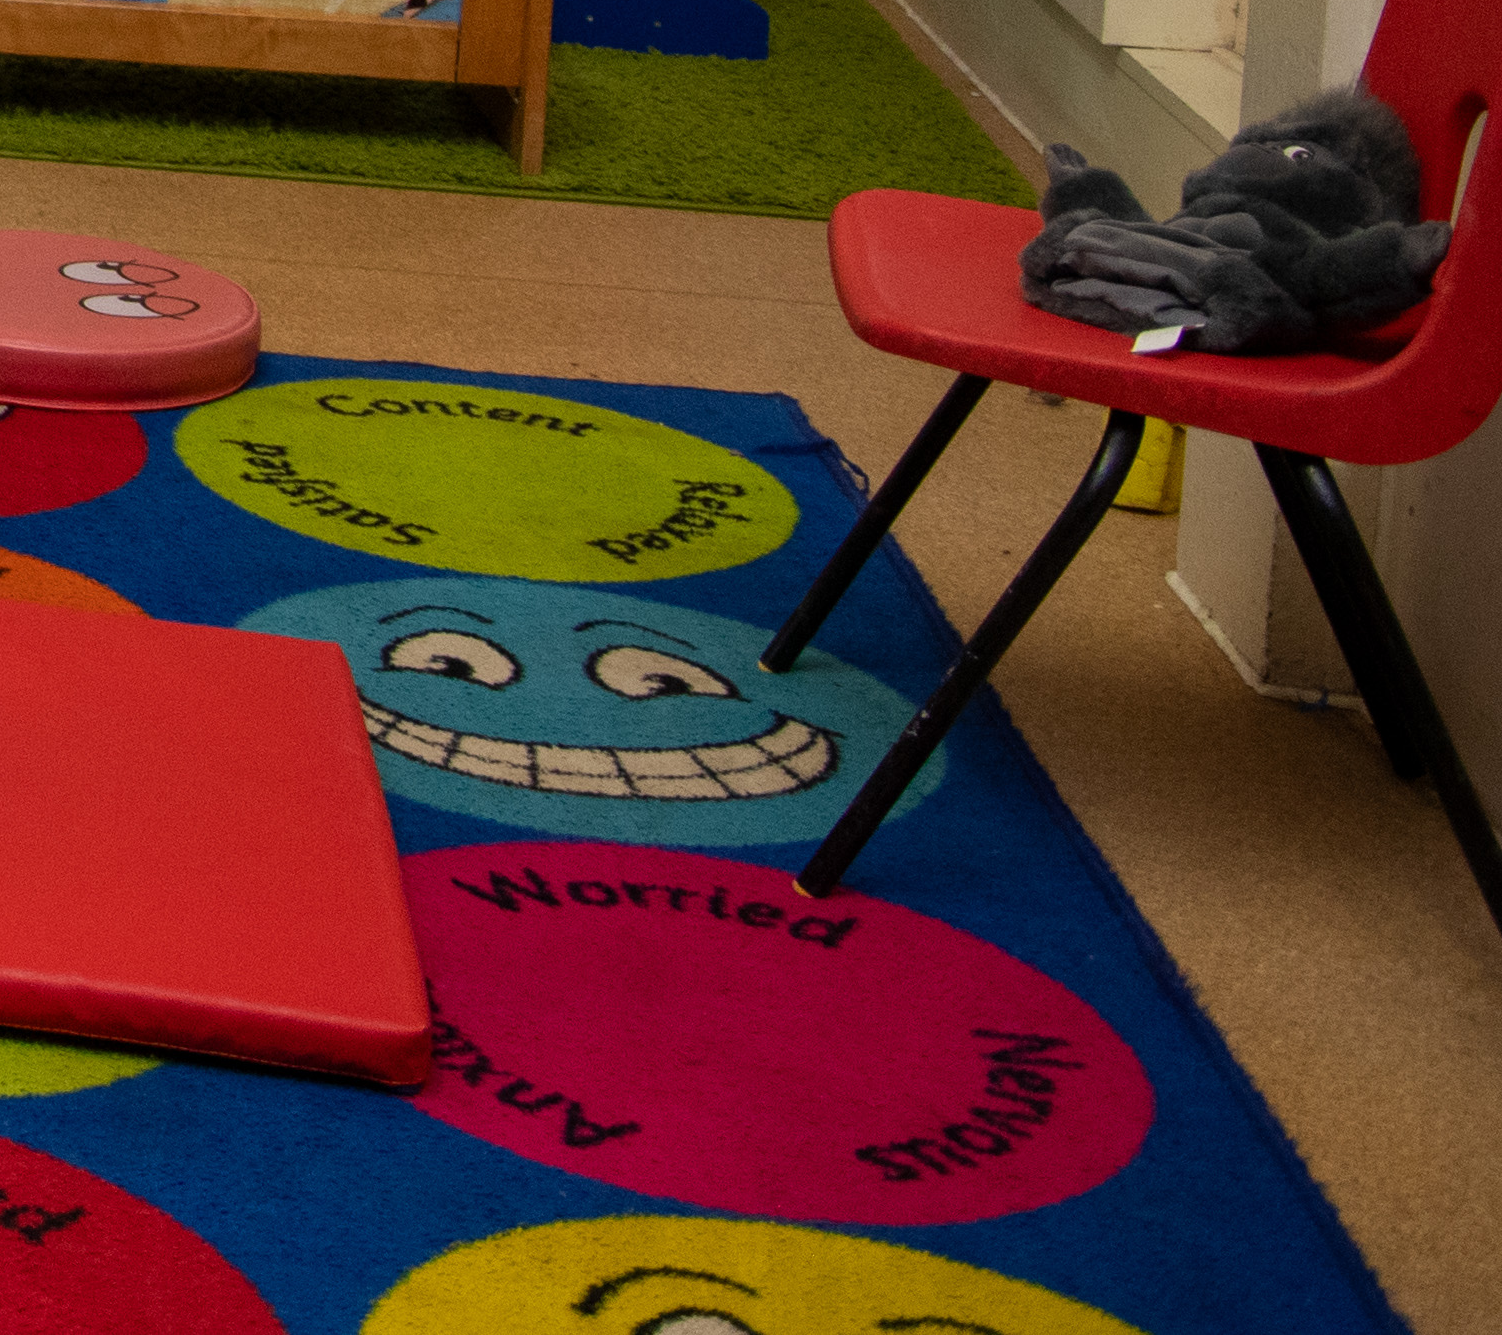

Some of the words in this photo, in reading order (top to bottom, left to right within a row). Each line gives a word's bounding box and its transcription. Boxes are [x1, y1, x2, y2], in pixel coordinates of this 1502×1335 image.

[315, 394, 600, 439] Content
[220, 439, 439, 545] Satisfied
[585, 479, 754, 564] Relaxed
[450, 867, 859, 949] Worried
[855, 1028, 1085, 1184] Nervous
